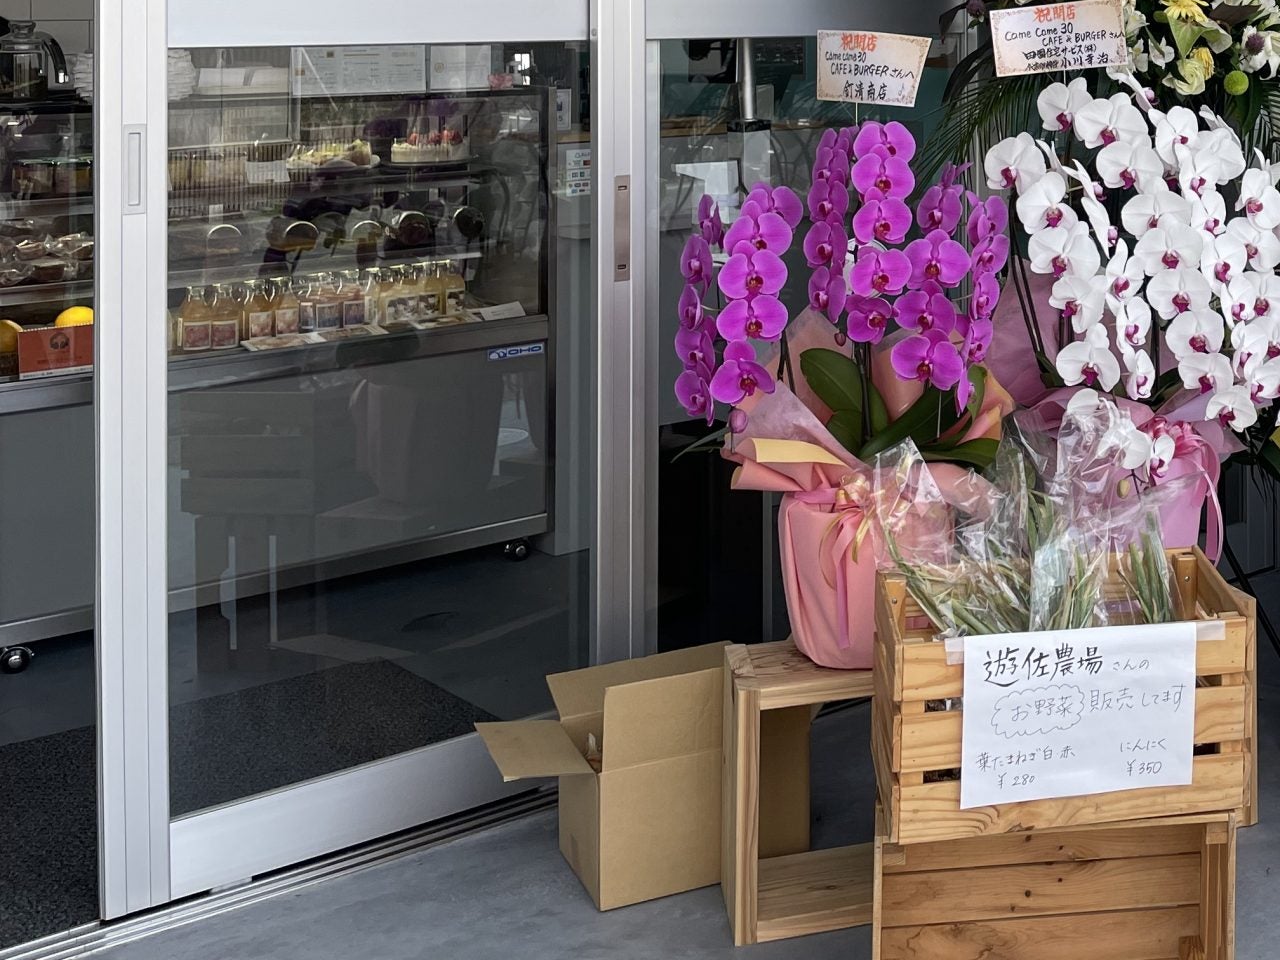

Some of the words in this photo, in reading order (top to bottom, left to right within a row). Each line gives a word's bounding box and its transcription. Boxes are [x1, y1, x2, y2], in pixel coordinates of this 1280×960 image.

[1034, 4, 1077, 23] 祝開店
[1060, 22, 1074, 35] 30
[841, 32, 878, 52] 祝開店
[1042, 36, 1063, 47] CAFE
[1075, 29, 1107, 42] BURGER
[854, 64, 890, 78] BURGER
[983, 642, 1104, 688] 遊佐農場
[1010, 695, 1074, 723] お野菜
[1120, 737, 1168, 753] にんにく
